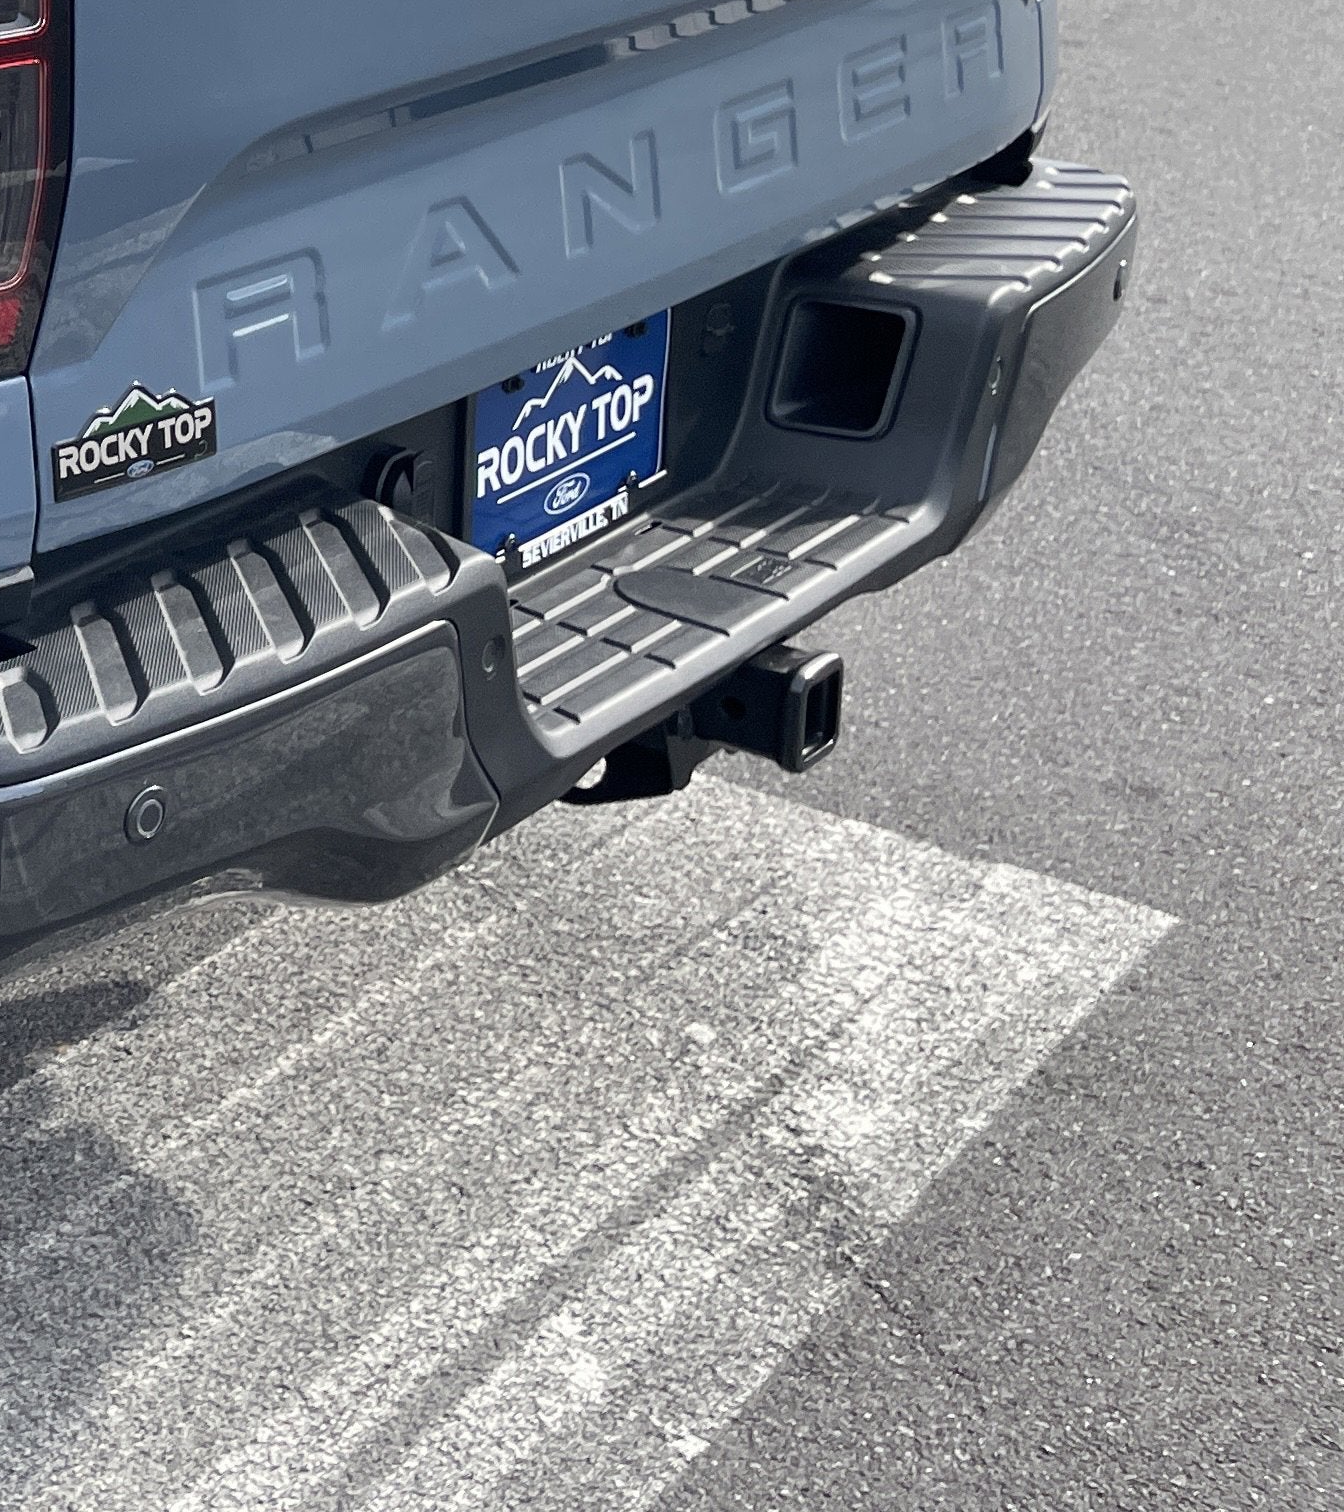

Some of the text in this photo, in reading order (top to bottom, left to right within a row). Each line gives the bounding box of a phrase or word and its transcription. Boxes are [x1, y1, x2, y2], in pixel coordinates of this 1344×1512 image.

[58, 407, 212, 479] ROCKY TOP
[477, 374, 655, 498] ROCKY TOP
[552, 479, 582, 509] Ford
